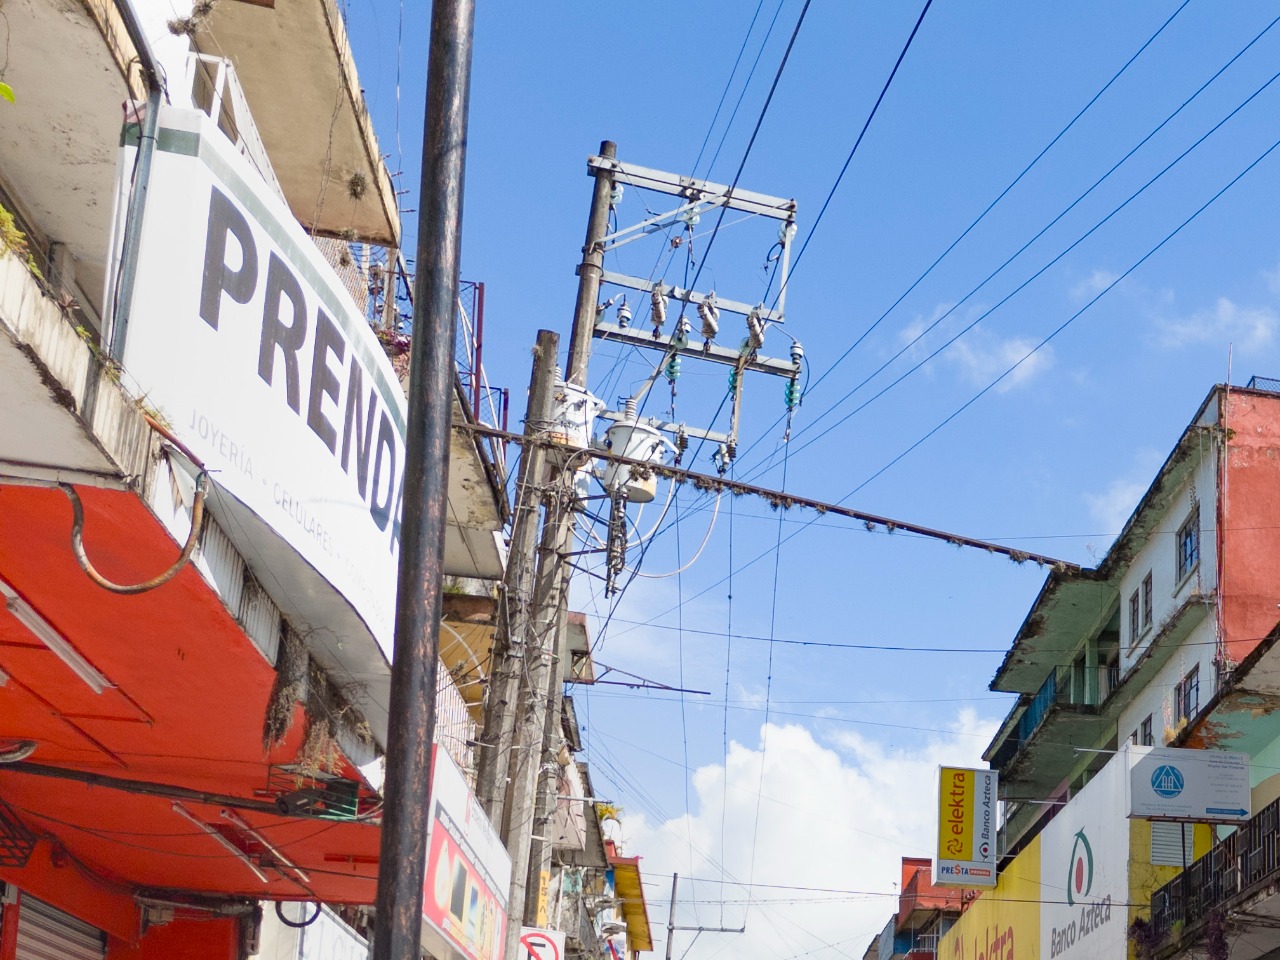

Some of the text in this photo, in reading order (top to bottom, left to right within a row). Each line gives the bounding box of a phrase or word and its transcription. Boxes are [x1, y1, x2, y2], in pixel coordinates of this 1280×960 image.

[188, 408, 336, 558] JOYERÍA CELULARES
[947, 772, 965, 835] elektra
[982, 774, 991, 840] Banco Azteca
[1051, 894, 1111, 959] Banco Azteca
